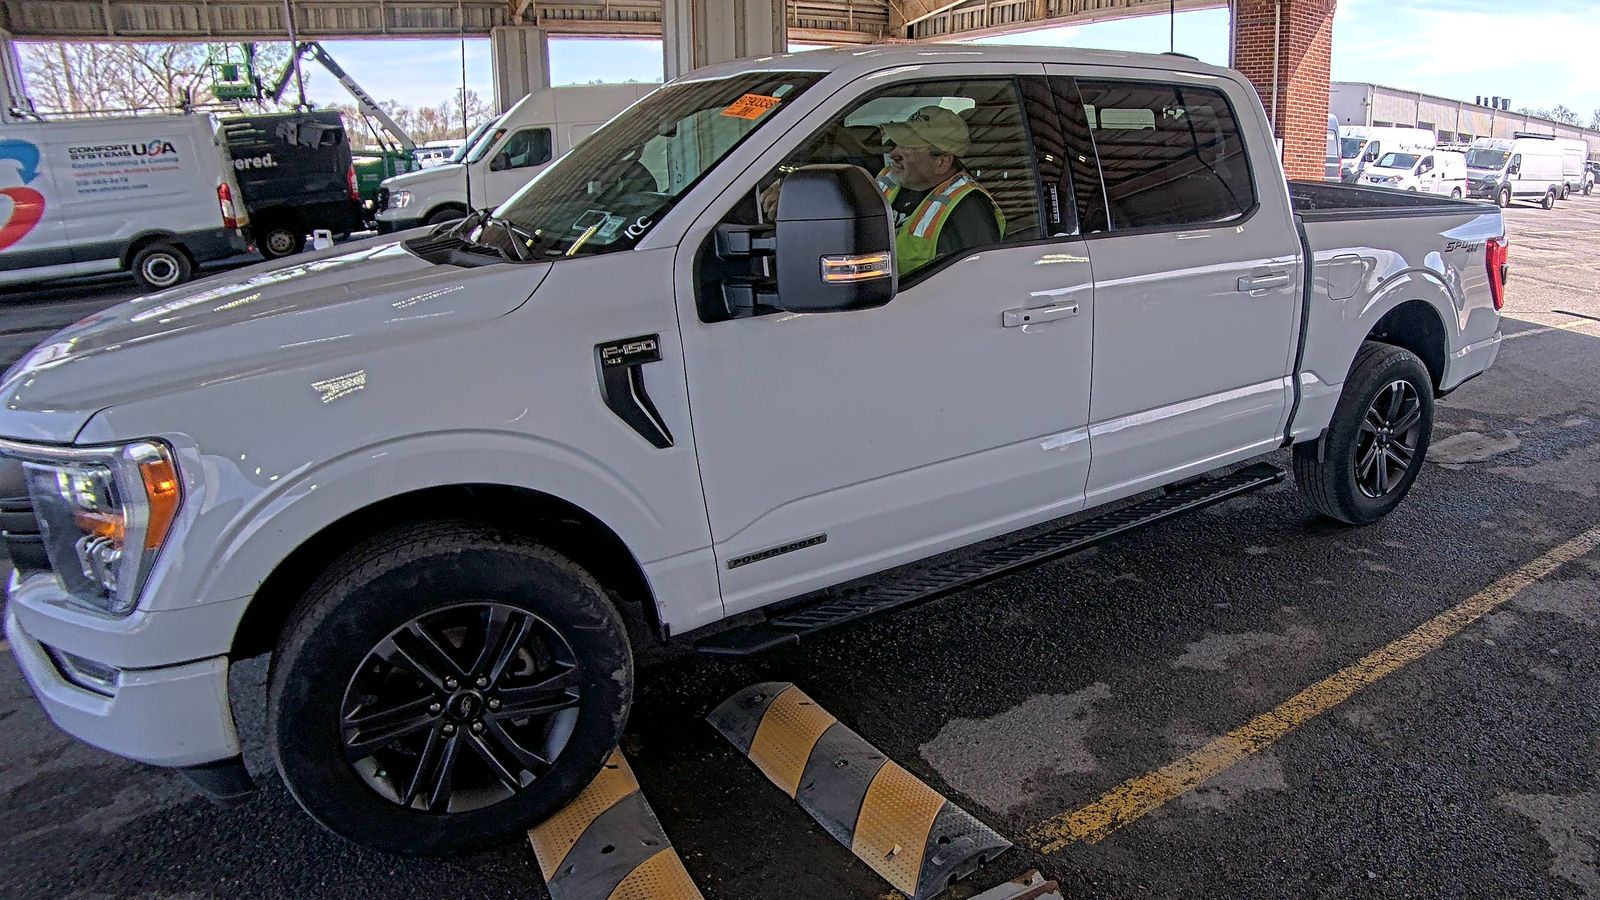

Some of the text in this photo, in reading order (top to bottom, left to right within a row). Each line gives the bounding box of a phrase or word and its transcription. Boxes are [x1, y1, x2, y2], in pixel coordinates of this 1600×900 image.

[69, 144, 129, 154] COMFORT
[70, 151, 132, 160] SYSTEMS
[132, 139, 176, 156] USA
[231, 153, 278, 170] ered.
[624, 216, 652, 239] ICC
[1444, 241, 1479, 252] SPORT
[603, 340, 656, 358] F-150
[607, 357, 623, 365] XLT
[733, 535, 824, 565] POWERBOOST
